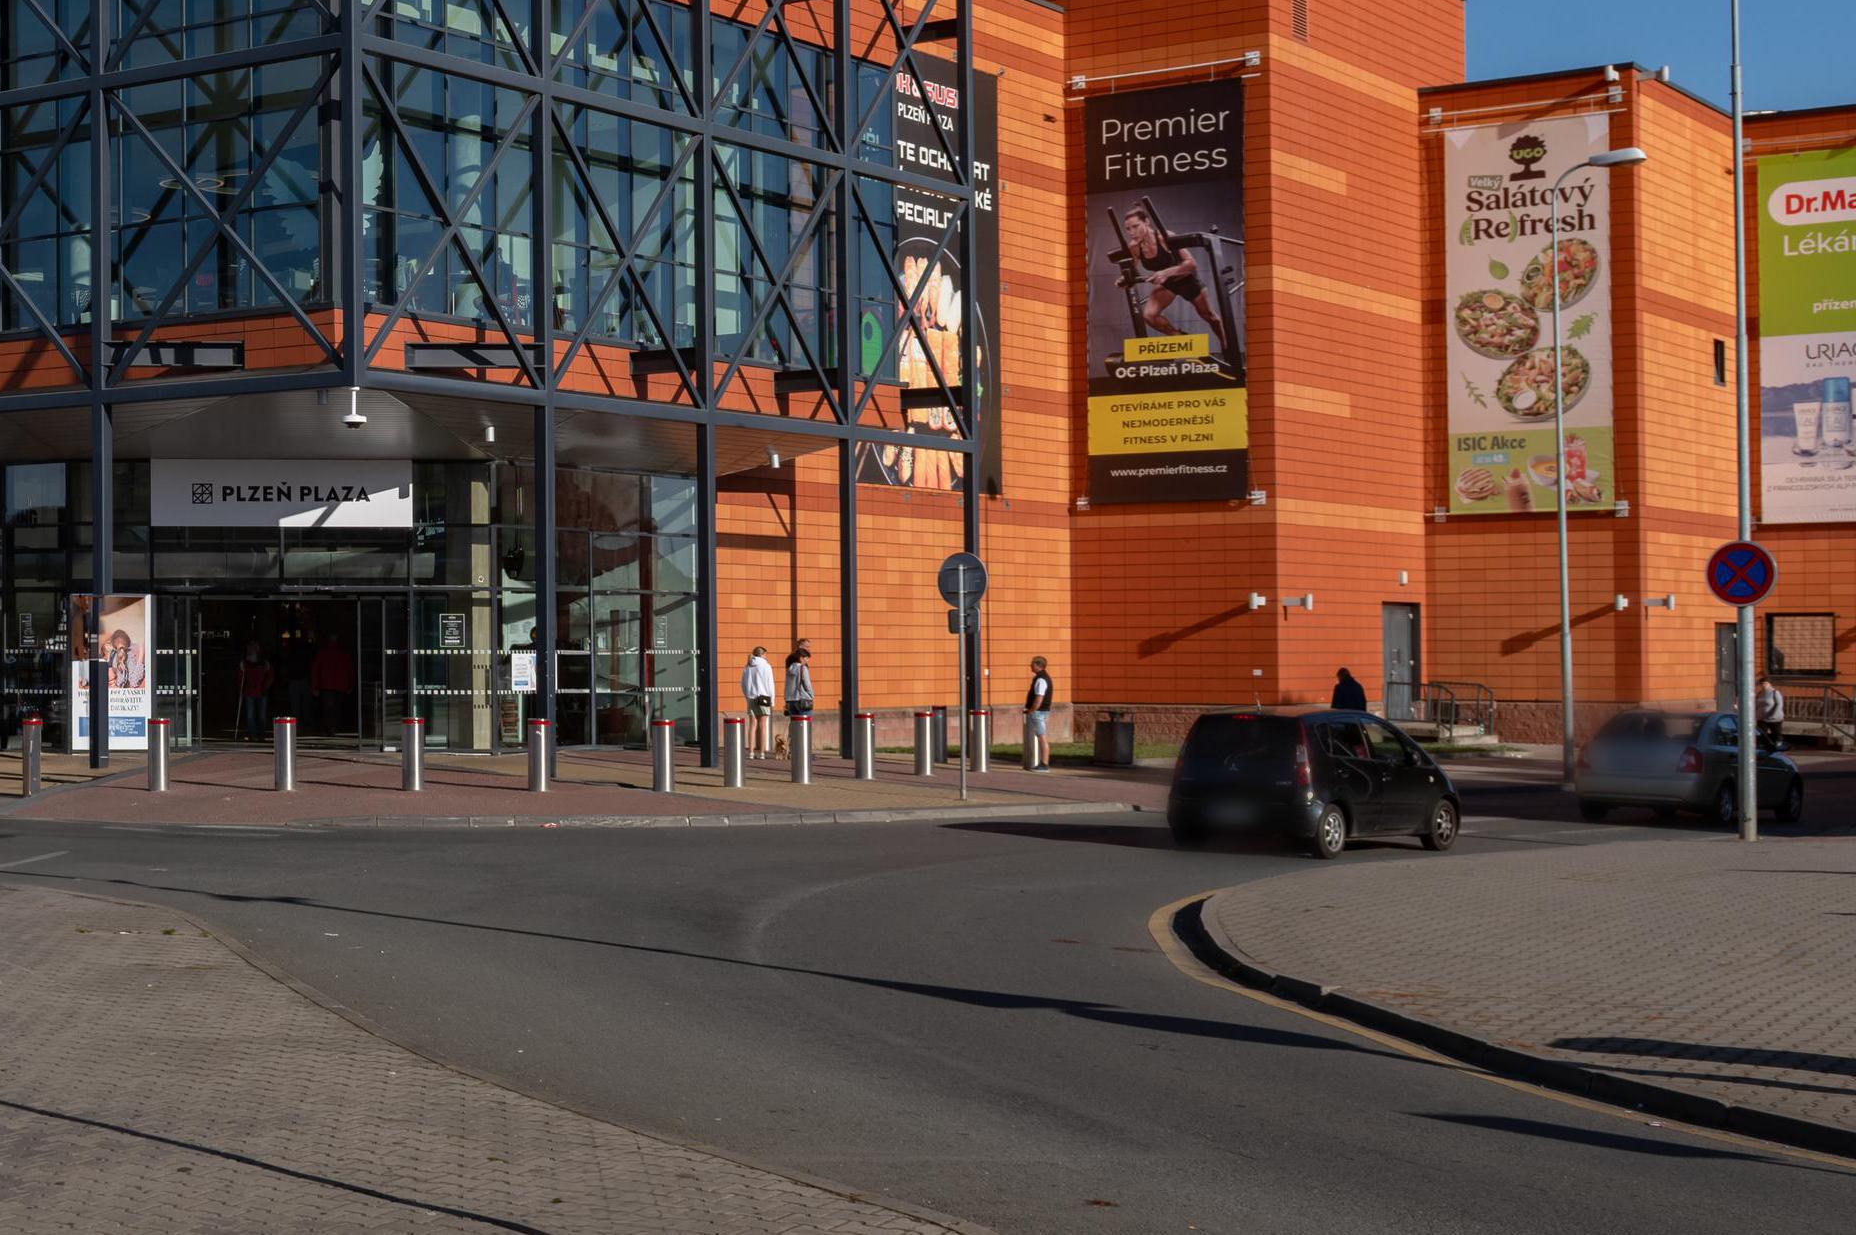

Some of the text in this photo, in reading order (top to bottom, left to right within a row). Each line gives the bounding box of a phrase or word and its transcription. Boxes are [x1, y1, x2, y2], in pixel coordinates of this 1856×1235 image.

[898, 102, 925, 123] PLZEŇ
[1102, 108, 1230, 145] Premier
[1512, 147, 1544, 159] UGO
[1105, 147, 1228, 180] Fitness
[1470, 177, 1502, 190] Velký
[1466, 177, 1595, 213] Salátový
[1139, 339, 1193, 354] PŘÍZEMÍ
[1115, 362, 1219, 379] OC Plzeň Plaza
[1110, 396, 1227, 413] OTEVÍRÁME PRO VÁS
[1122, 414, 1215, 428] NEJMODERNĚJŠÍ
[1123, 433, 1214, 445] FITNESS V PLZNI
[1457, 435, 1527, 452] ISIC Akce
[1110, 464, 1228, 478] www.premierfitness.cz
[221, 481, 371, 502] PLZEŇ PLAZA
